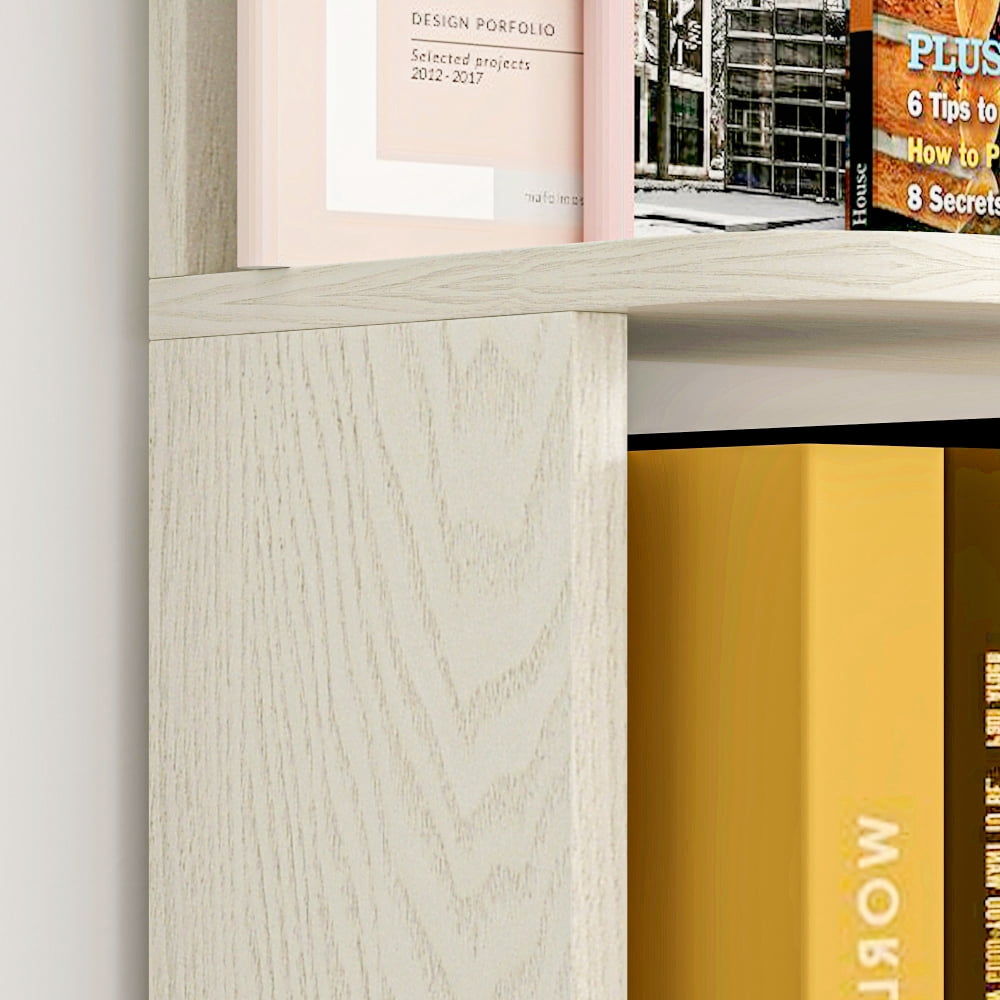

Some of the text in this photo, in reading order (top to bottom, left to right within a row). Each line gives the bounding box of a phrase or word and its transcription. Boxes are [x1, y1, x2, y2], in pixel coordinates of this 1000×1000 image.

[412, 12, 555, 36] DESIGN PORFOLIO
[411, 48, 530, 72] Selected projects
[907, 90, 922, 118] 6
[929, 92, 972, 124] Tips
[977, 96, 998, 123] to
[907, 136, 952, 165] How
[958, 142, 980, 168] to
[852, 162, 868, 227] House
[907, 183, 922, 211] 8
